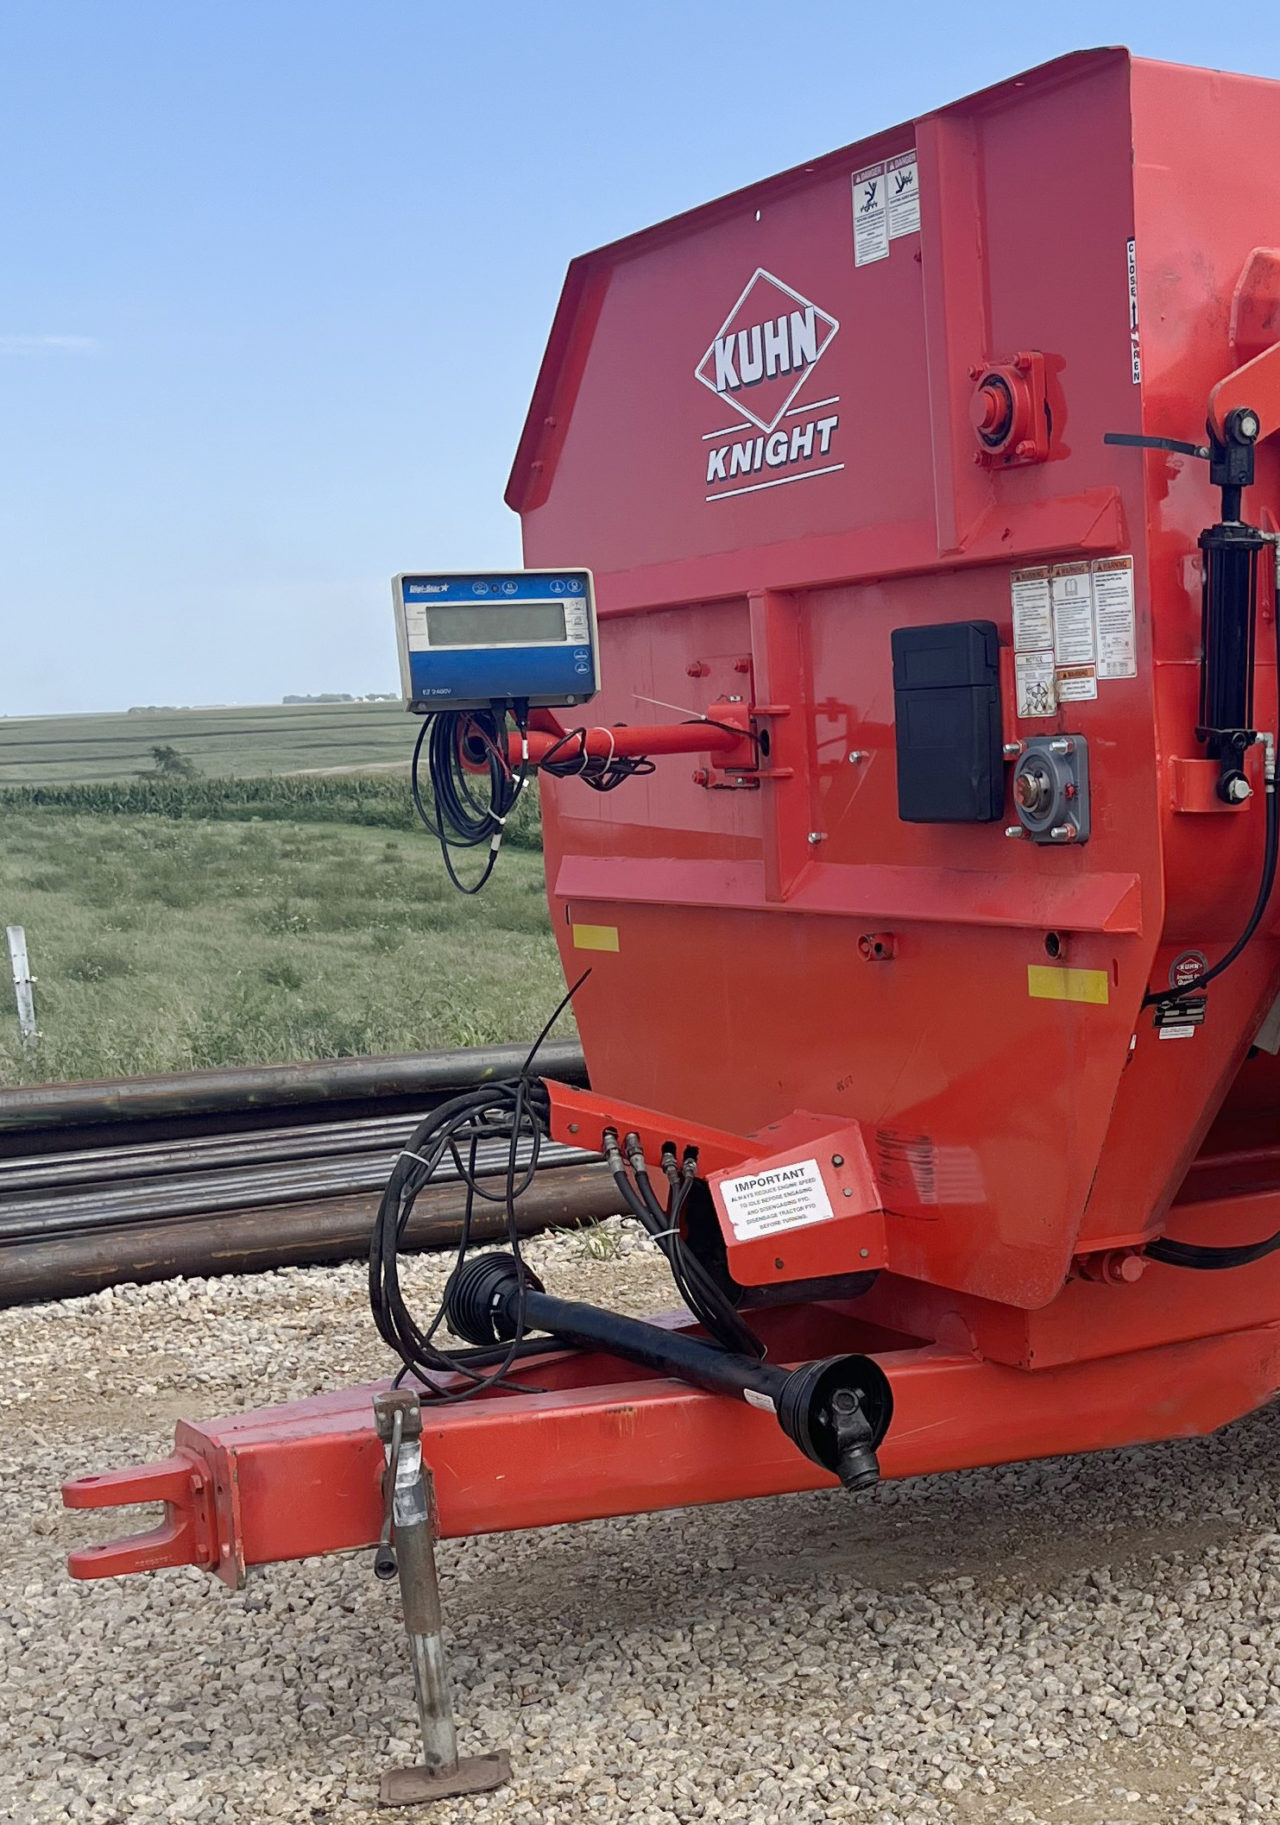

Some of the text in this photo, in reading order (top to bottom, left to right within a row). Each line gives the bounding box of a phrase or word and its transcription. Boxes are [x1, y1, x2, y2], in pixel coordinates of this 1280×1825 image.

[1128, 243, 1137, 298] CLOSE
[714, 306, 817, 392] KUHN
[706, 415, 839, 484] KNIGHT
[732, 1177, 816, 1202] ALWAYS REDUCE ENGINE SPEED
[735, 1168, 806, 1192] IMPORTANT
[760, 1200, 797, 1212] DISENGAGING
[762, 1195, 783, 1203] BEFORE
[784, 1187, 812, 1197] ENGAGING
[780, 1207, 804, 1216] TRACTOR
[760, 1221, 781, 1229] BEFORE
